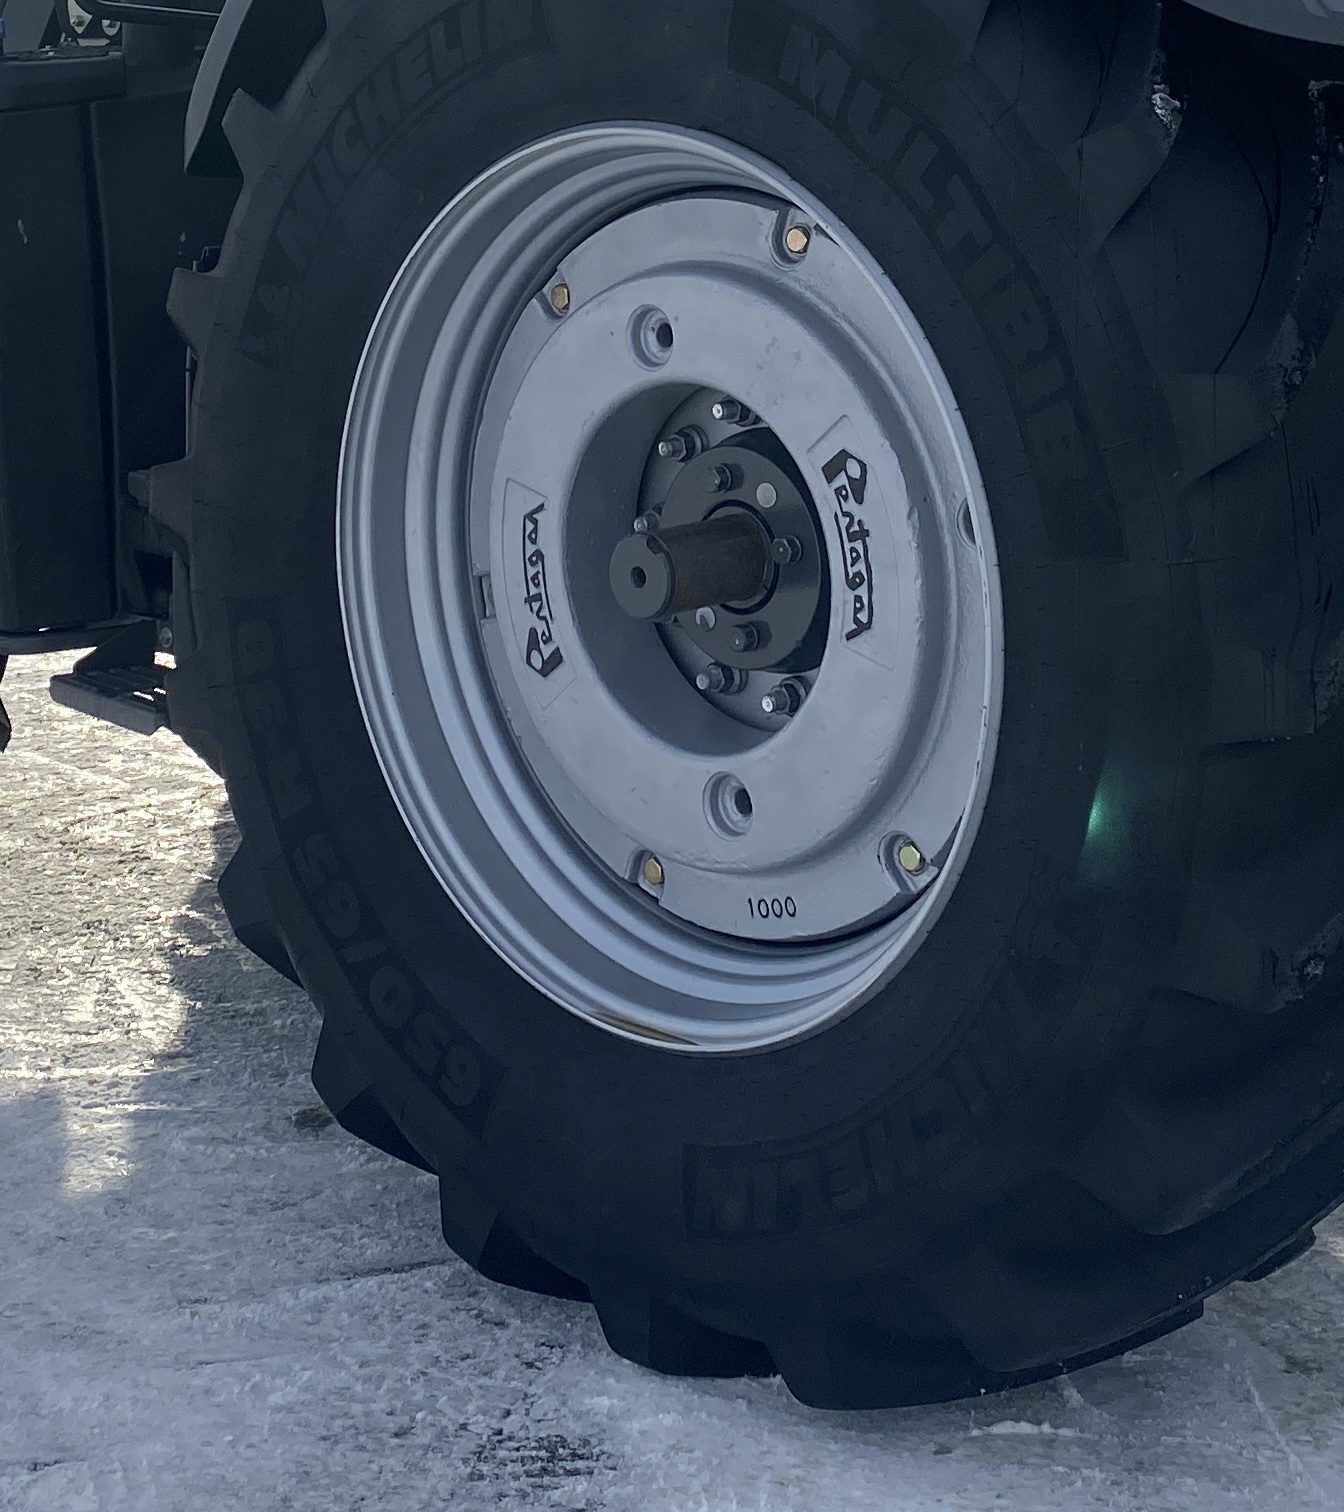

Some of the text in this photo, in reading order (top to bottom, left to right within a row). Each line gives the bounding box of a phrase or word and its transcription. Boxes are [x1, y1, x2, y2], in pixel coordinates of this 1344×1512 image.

[778, 24, 1090, 484] MULTIBIB
[524, 501, 564, 678] Pentagon
[820, 448, 875, 642] Pentagon
[747, 896, 797, 919] 1000
